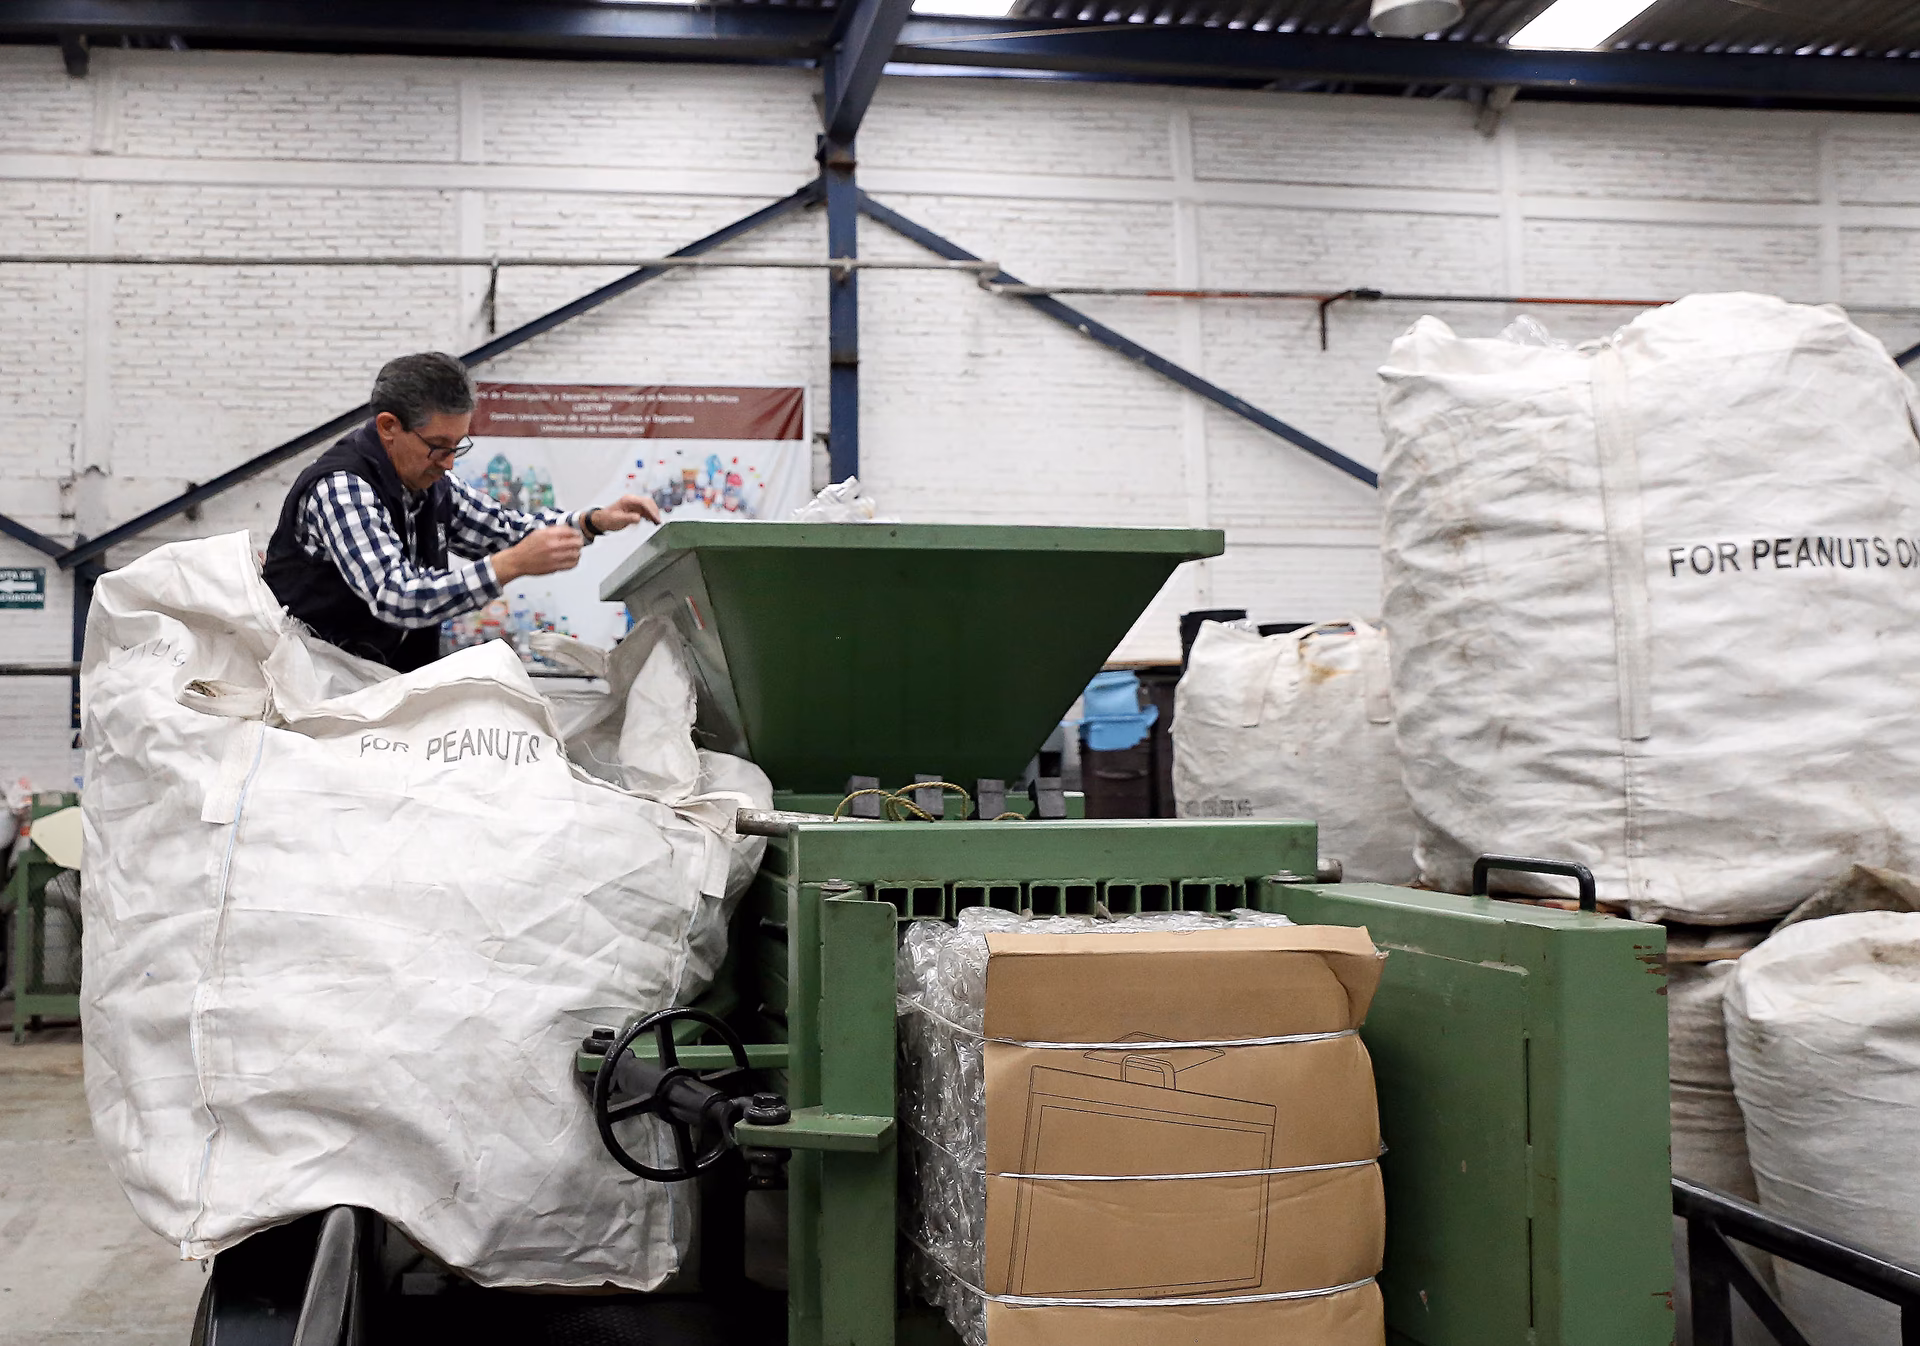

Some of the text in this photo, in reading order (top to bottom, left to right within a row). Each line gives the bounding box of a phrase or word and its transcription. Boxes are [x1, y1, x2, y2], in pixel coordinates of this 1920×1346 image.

[1668, 542, 1741, 577] FOR
[1752, 536, 1891, 570] PEANUTS
[360, 728, 541, 766] FOR PEANUTS
